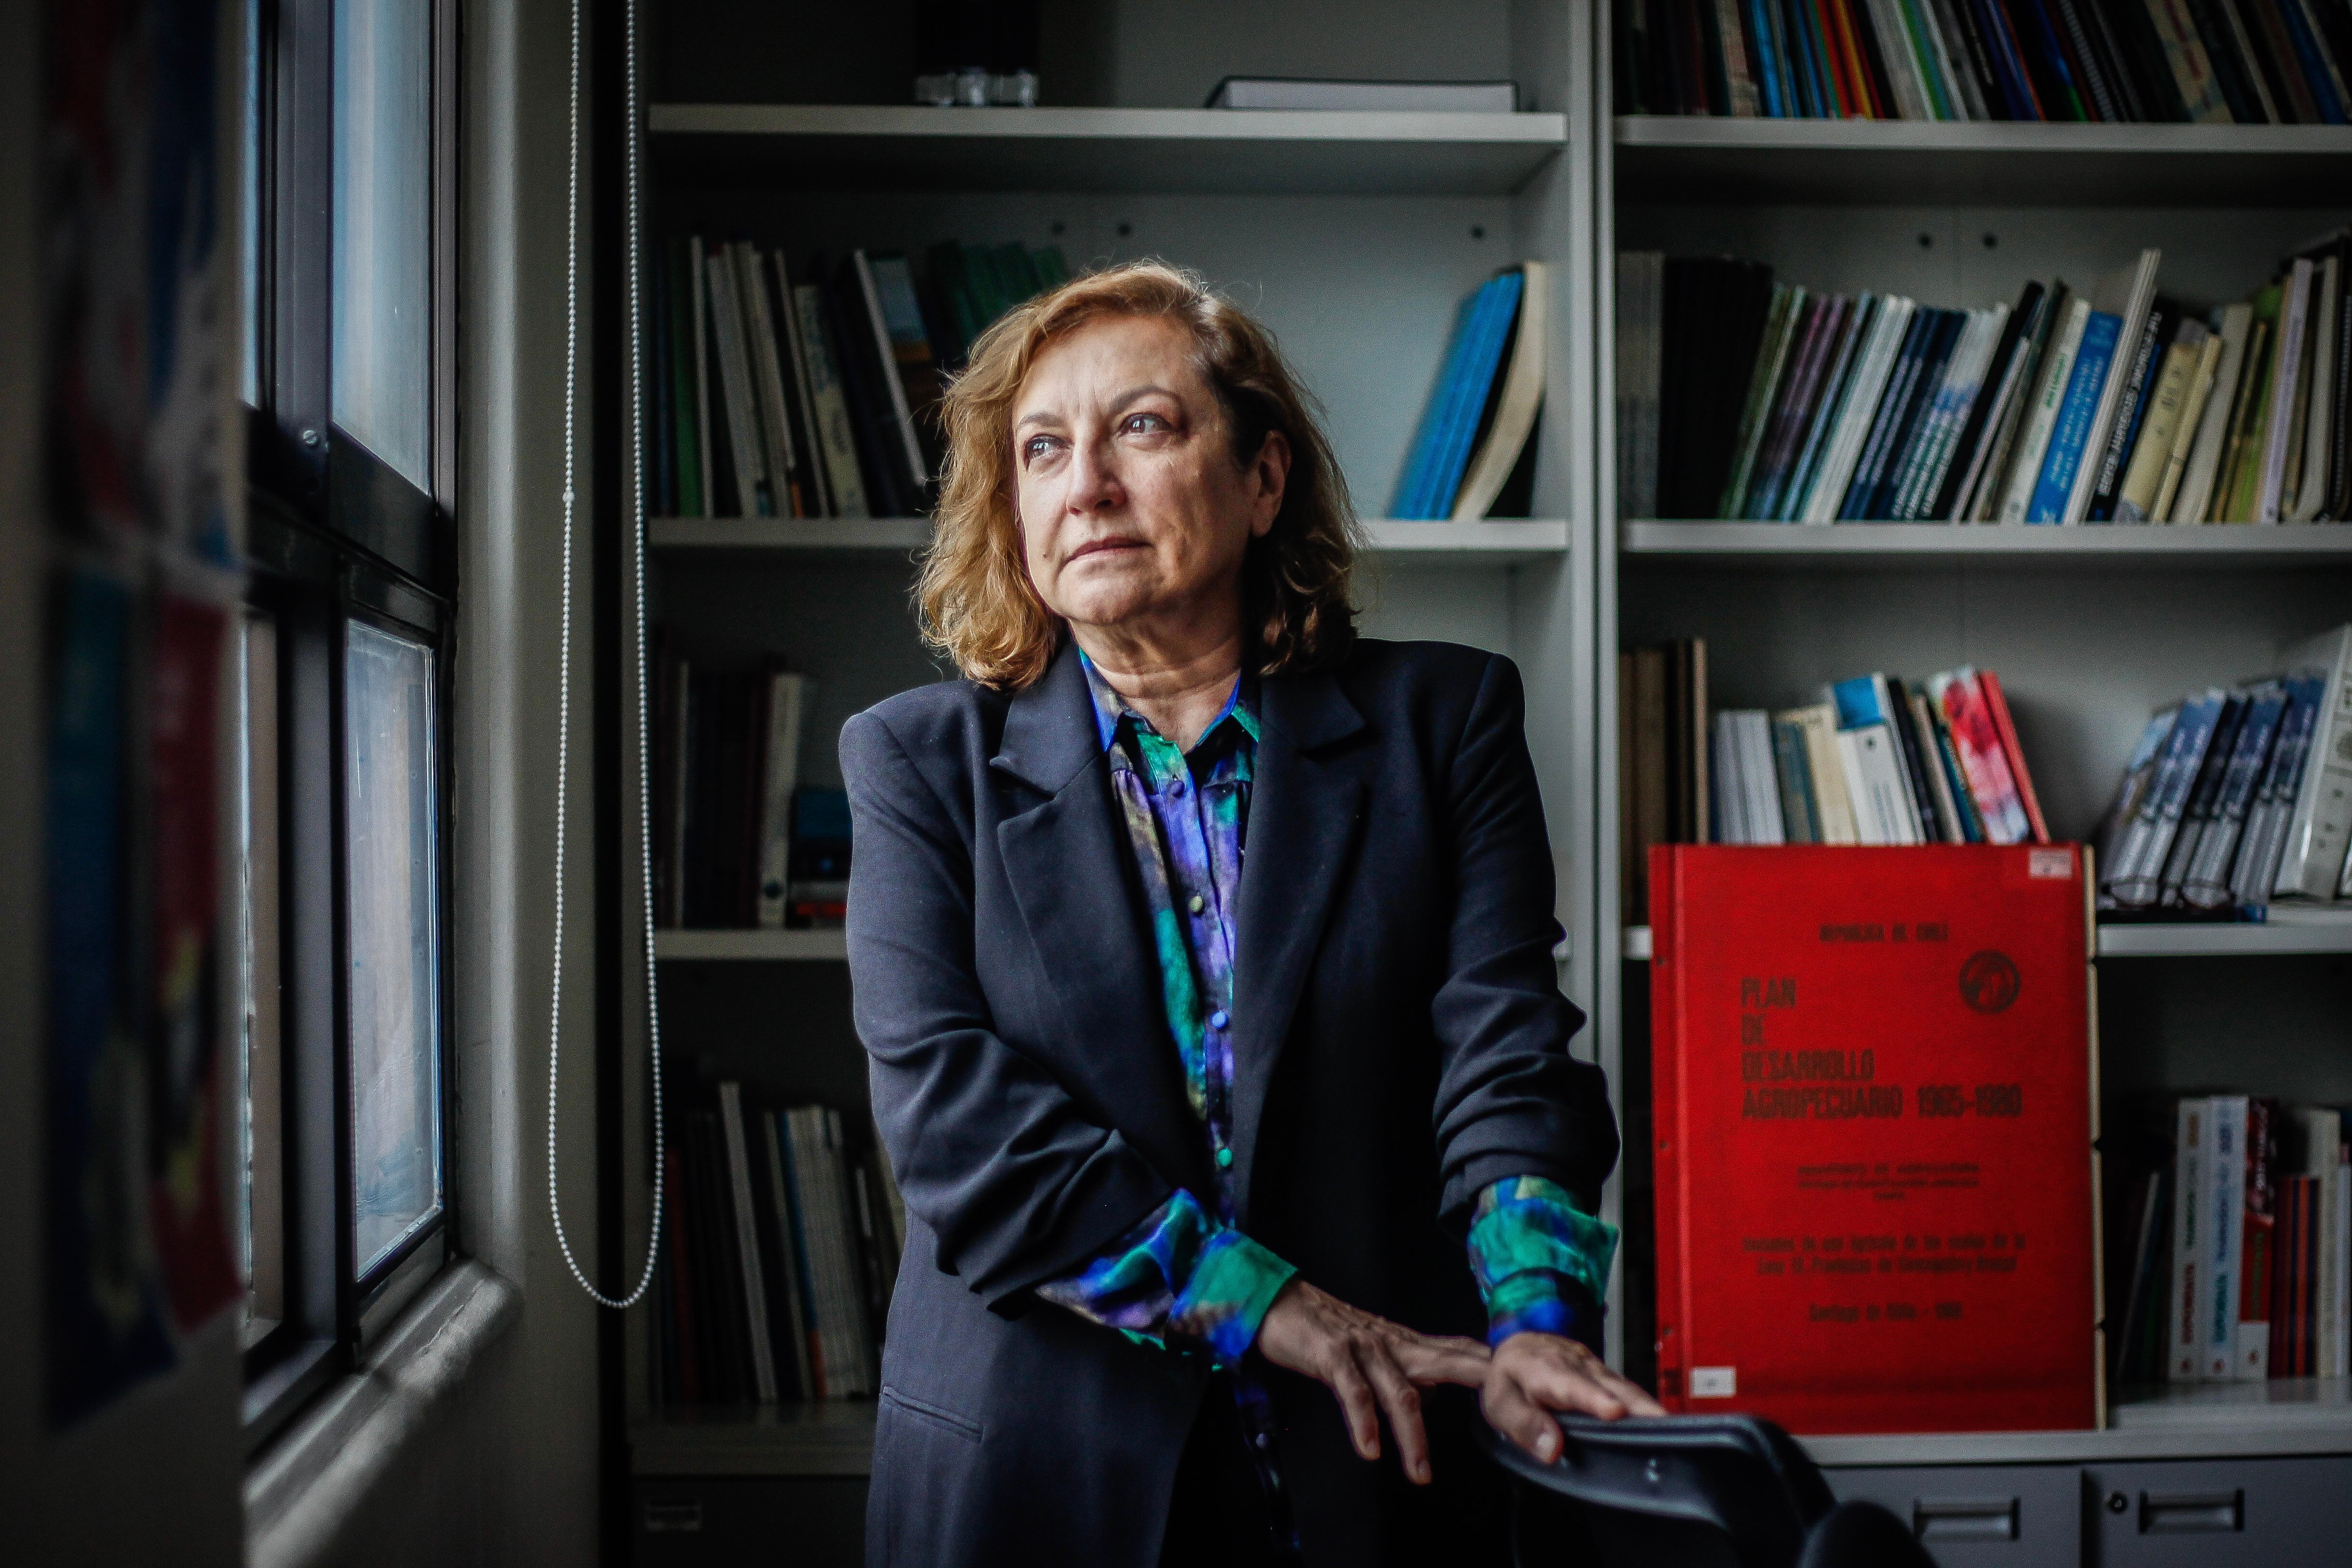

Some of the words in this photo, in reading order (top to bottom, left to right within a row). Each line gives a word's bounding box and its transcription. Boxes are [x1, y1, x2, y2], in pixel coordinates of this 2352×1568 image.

[1741, 977, 1797, 1008] PLAN
[1741, 1013, 1767, 1046] DE
[1741, 1049, 1875, 1082] DESARROLLO
[1741, 1085, 1904, 1119] AGROPECUARIO
